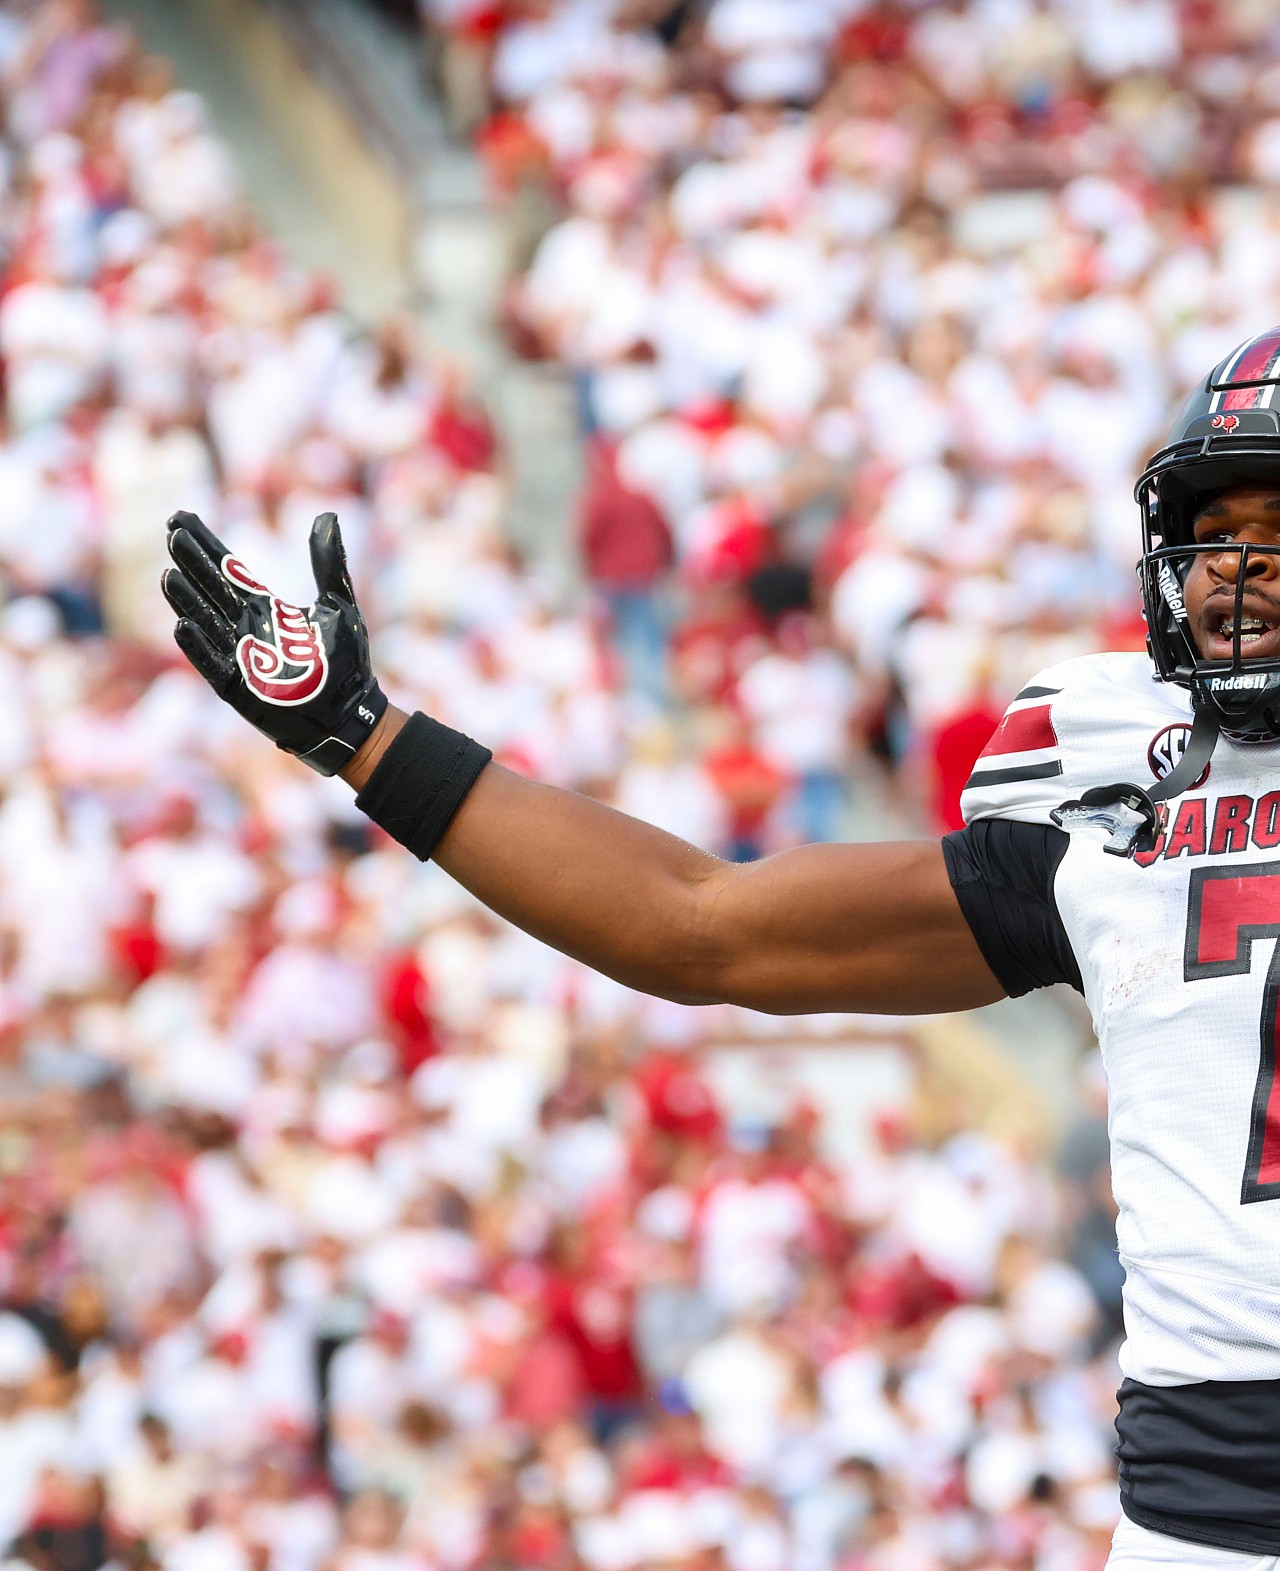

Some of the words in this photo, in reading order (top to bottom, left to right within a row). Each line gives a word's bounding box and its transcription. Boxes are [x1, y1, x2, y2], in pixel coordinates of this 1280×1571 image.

[1159, 565, 1188, 619] Riddell
[1211, 673, 1267, 691] Riddell
[1152, 727, 1203, 783] SE
